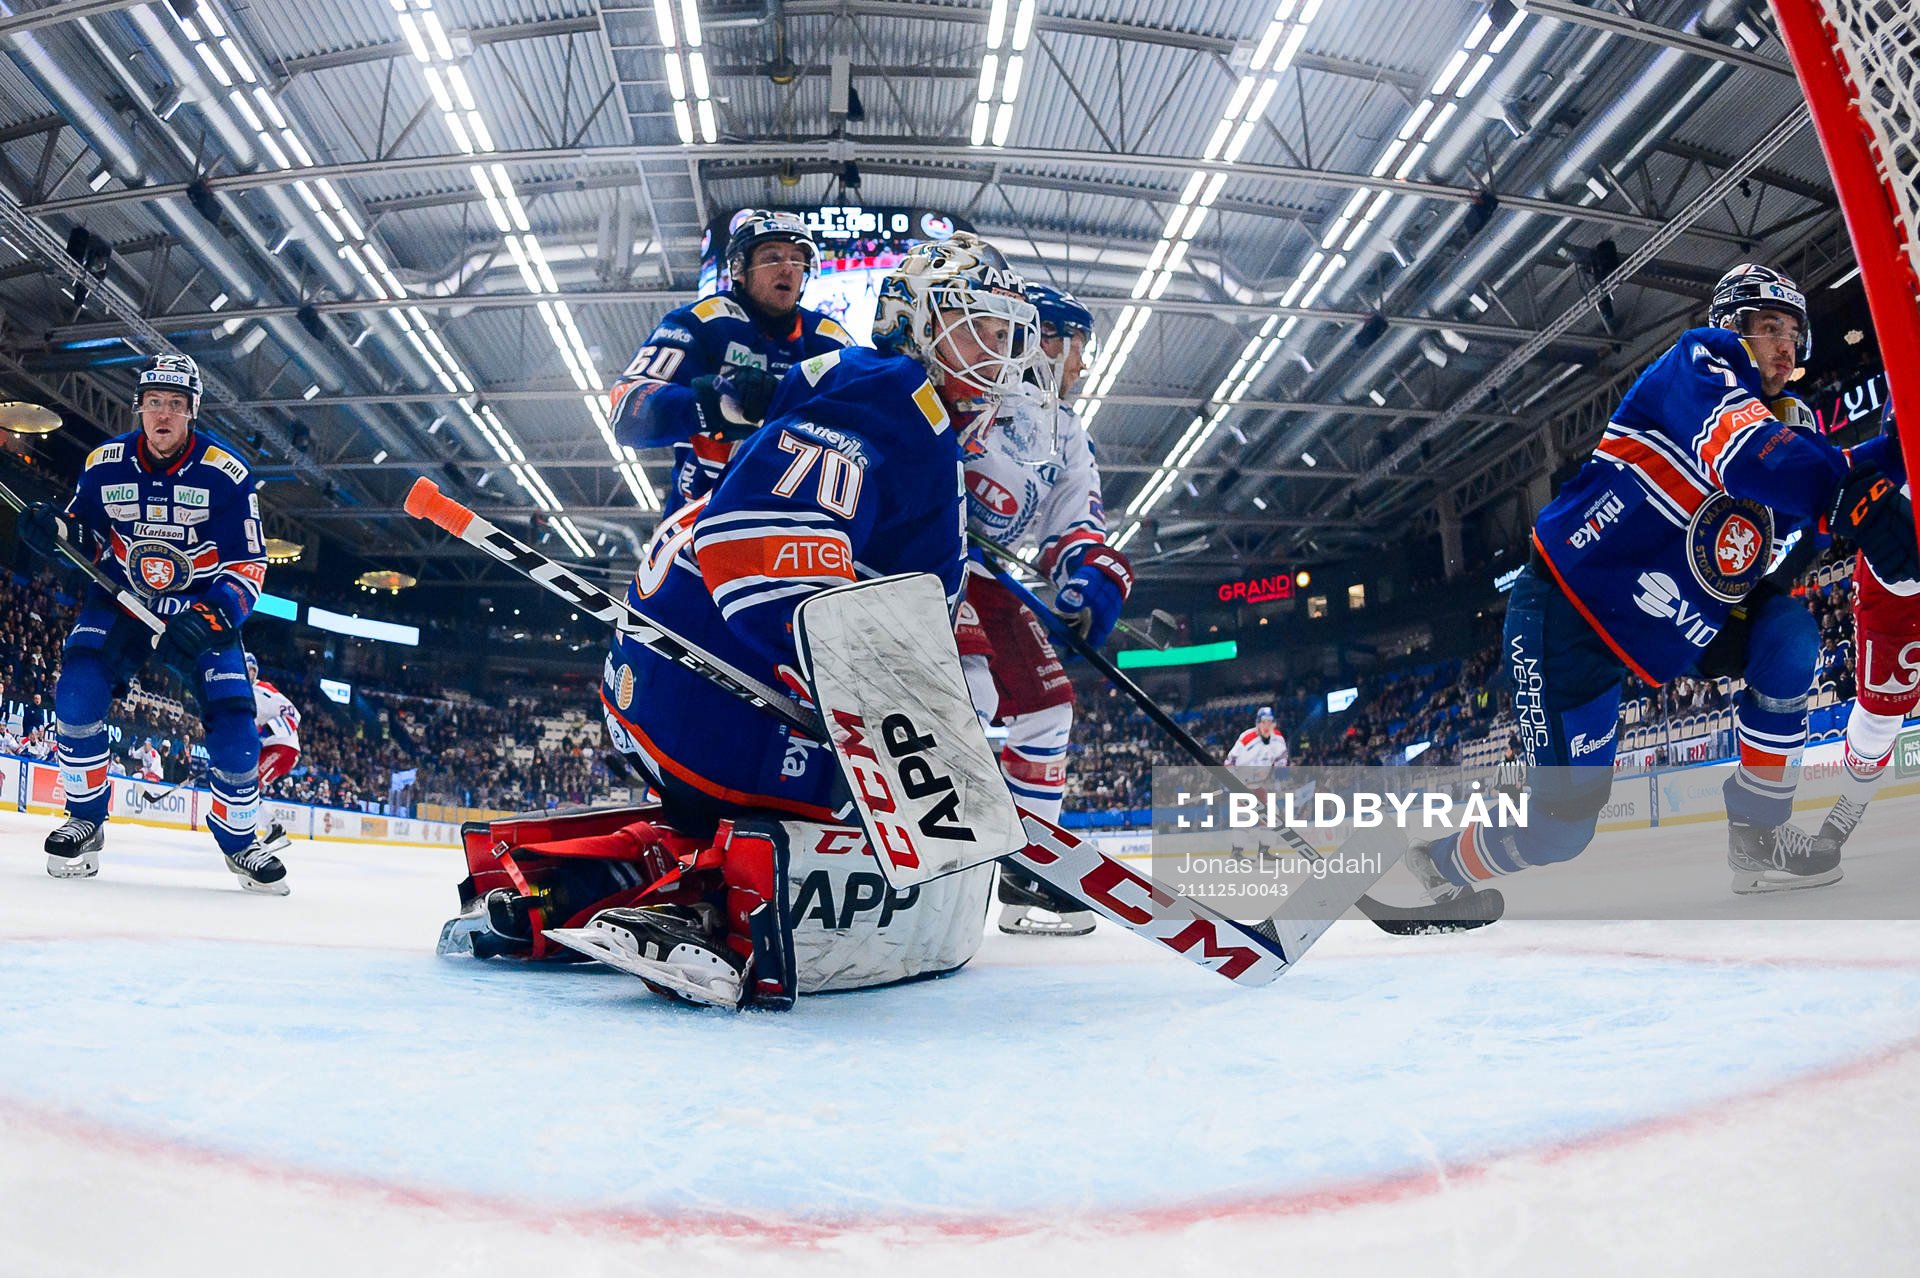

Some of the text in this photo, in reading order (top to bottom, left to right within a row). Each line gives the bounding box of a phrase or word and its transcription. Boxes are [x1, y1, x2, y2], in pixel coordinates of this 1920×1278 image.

[158, 373, 184, 385] OBOS
[622, 345, 686, 382] 60
[1730, 402, 1768, 428] ATE
[102, 446, 121, 461] put
[797, 421, 871, 472] Atteviks
[222, 460, 244, 480] put
[771, 429, 863, 520] 70
[105, 486, 134, 501] wilo
[178, 488, 205, 505] wilo
[974, 478, 1011, 512] IK
[1849, 477, 1895, 527] CC
[139, 524, 183, 538] Karlsson
[187, 526, 199, 545] A
[1218, 574, 1291, 602] GRAND
[1674, 599, 1719, 648] VID
[1510, 633, 1536, 767] WELLNESS
[1524, 657, 1549, 748] NORDIC
[831, 708, 920, 872] CCM
[881, 713, 977, 842] APP
[126, 783, 186, 815] dynacon
[791, 869, 921, 929] APP
[1001, 805, 1262, 981] CCM
